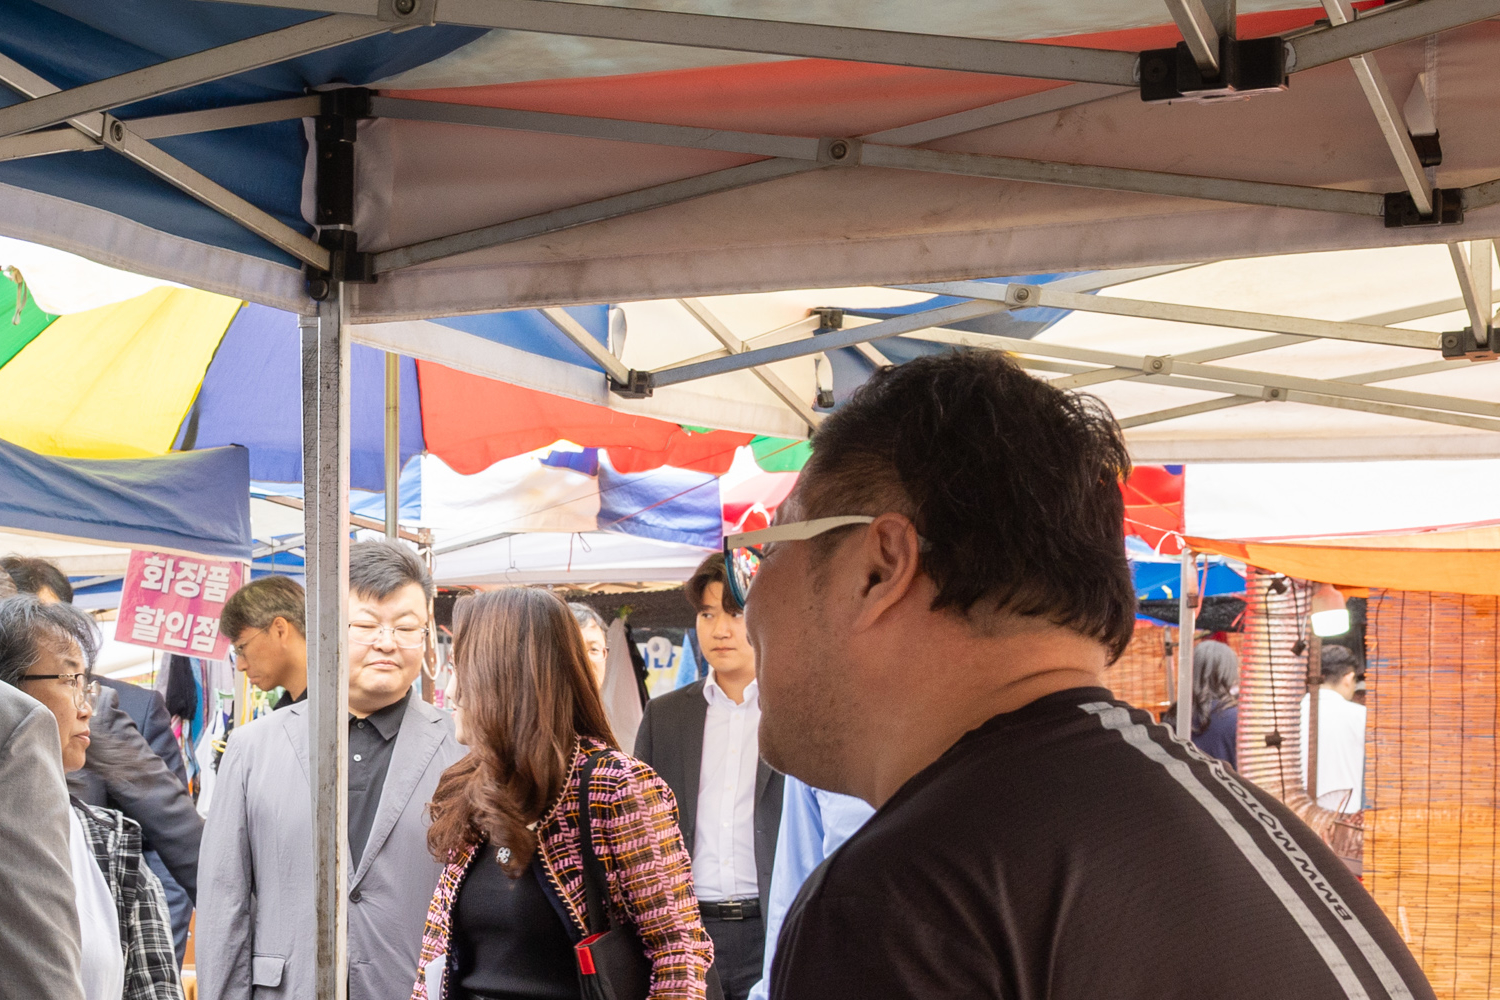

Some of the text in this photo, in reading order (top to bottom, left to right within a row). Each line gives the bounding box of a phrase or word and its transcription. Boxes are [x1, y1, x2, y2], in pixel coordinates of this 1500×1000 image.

[140, 556, 231, 603] 화장품
[131, 604, 221, 653] 할인점
[1294, 856, 1353, 922] BMW
